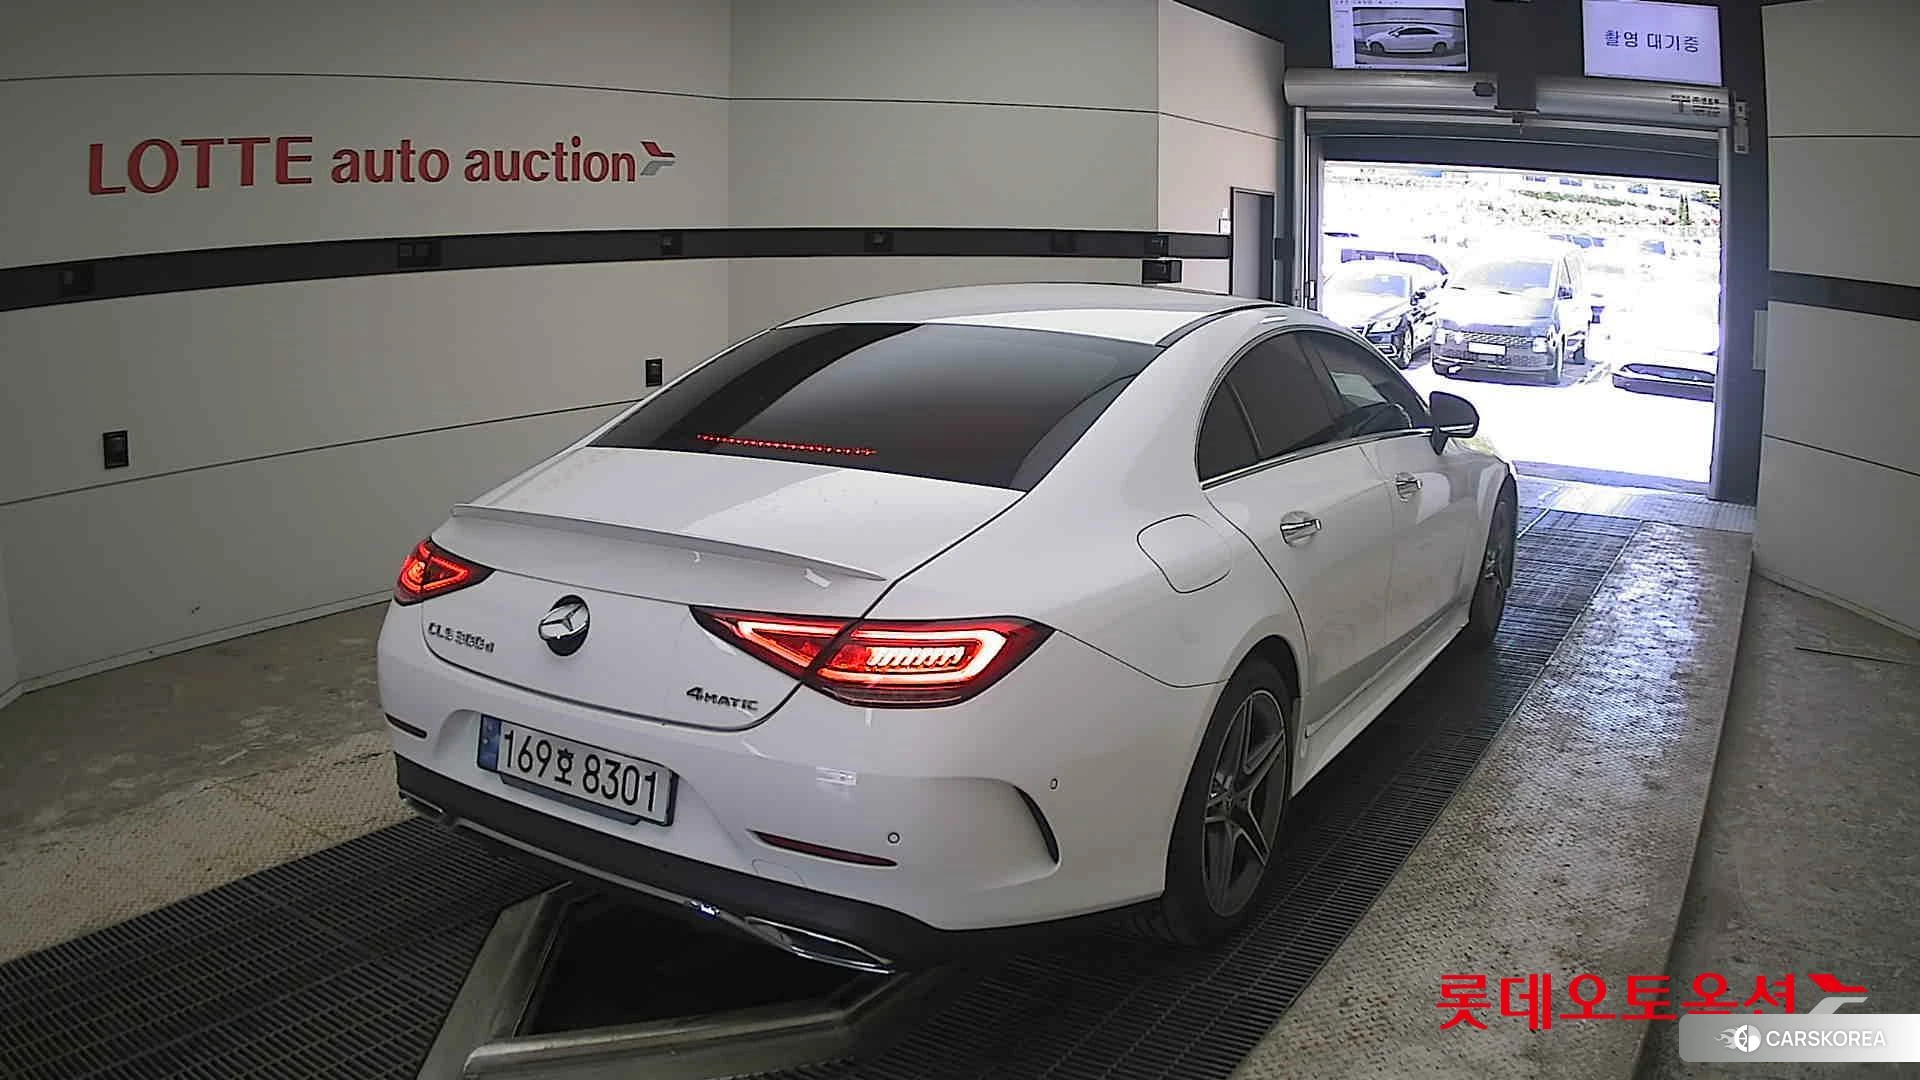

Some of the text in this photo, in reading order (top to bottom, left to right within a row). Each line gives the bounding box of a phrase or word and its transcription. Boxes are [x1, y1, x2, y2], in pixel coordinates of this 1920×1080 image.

[1646, 32, 1700, 53] 대기중
[89, 135, 636, 194] LOTTE auto auction
[685, 686, 759, 711] 4MATIC
[504, 729, 657, 812] 169호 8301
